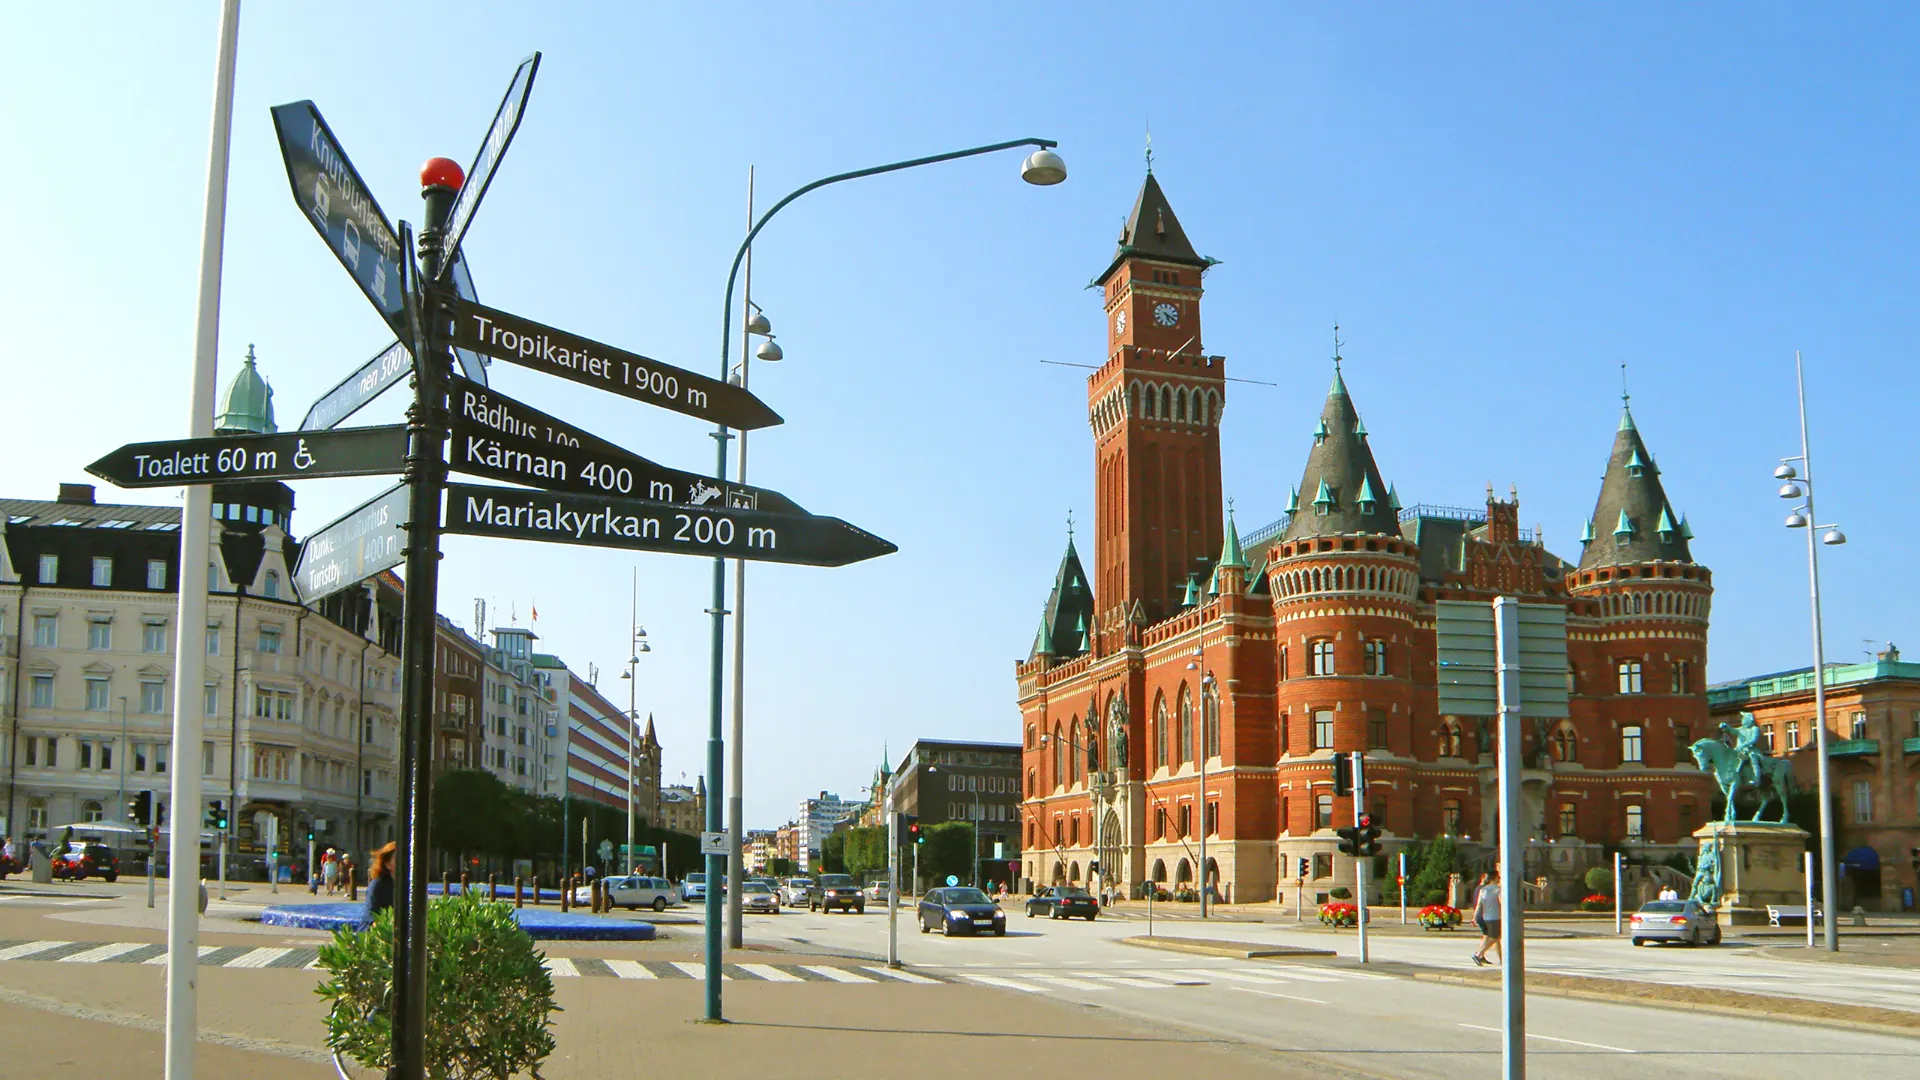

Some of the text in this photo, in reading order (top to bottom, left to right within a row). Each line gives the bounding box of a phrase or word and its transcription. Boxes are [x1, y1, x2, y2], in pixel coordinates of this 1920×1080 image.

[503, 101, 514, 131] m
[311, 119, 391, 260] Knutpunkten
[380, 346, 401, 381] 500
[473, 315, 707, 408] Tropikariet 1900 m
[463, 391, 537, 439] Rådhus
[135, 448, 277, 478] Toalett 60 m
[466, 437, 673, 503] Kärnan 400 m
[466, 496, 777, 549] Mariakyrkan 200 m
[309, 532, 342, 563] Dunke
[364, 535, 384, 564] 400
[386, 533, 397, 555] m
